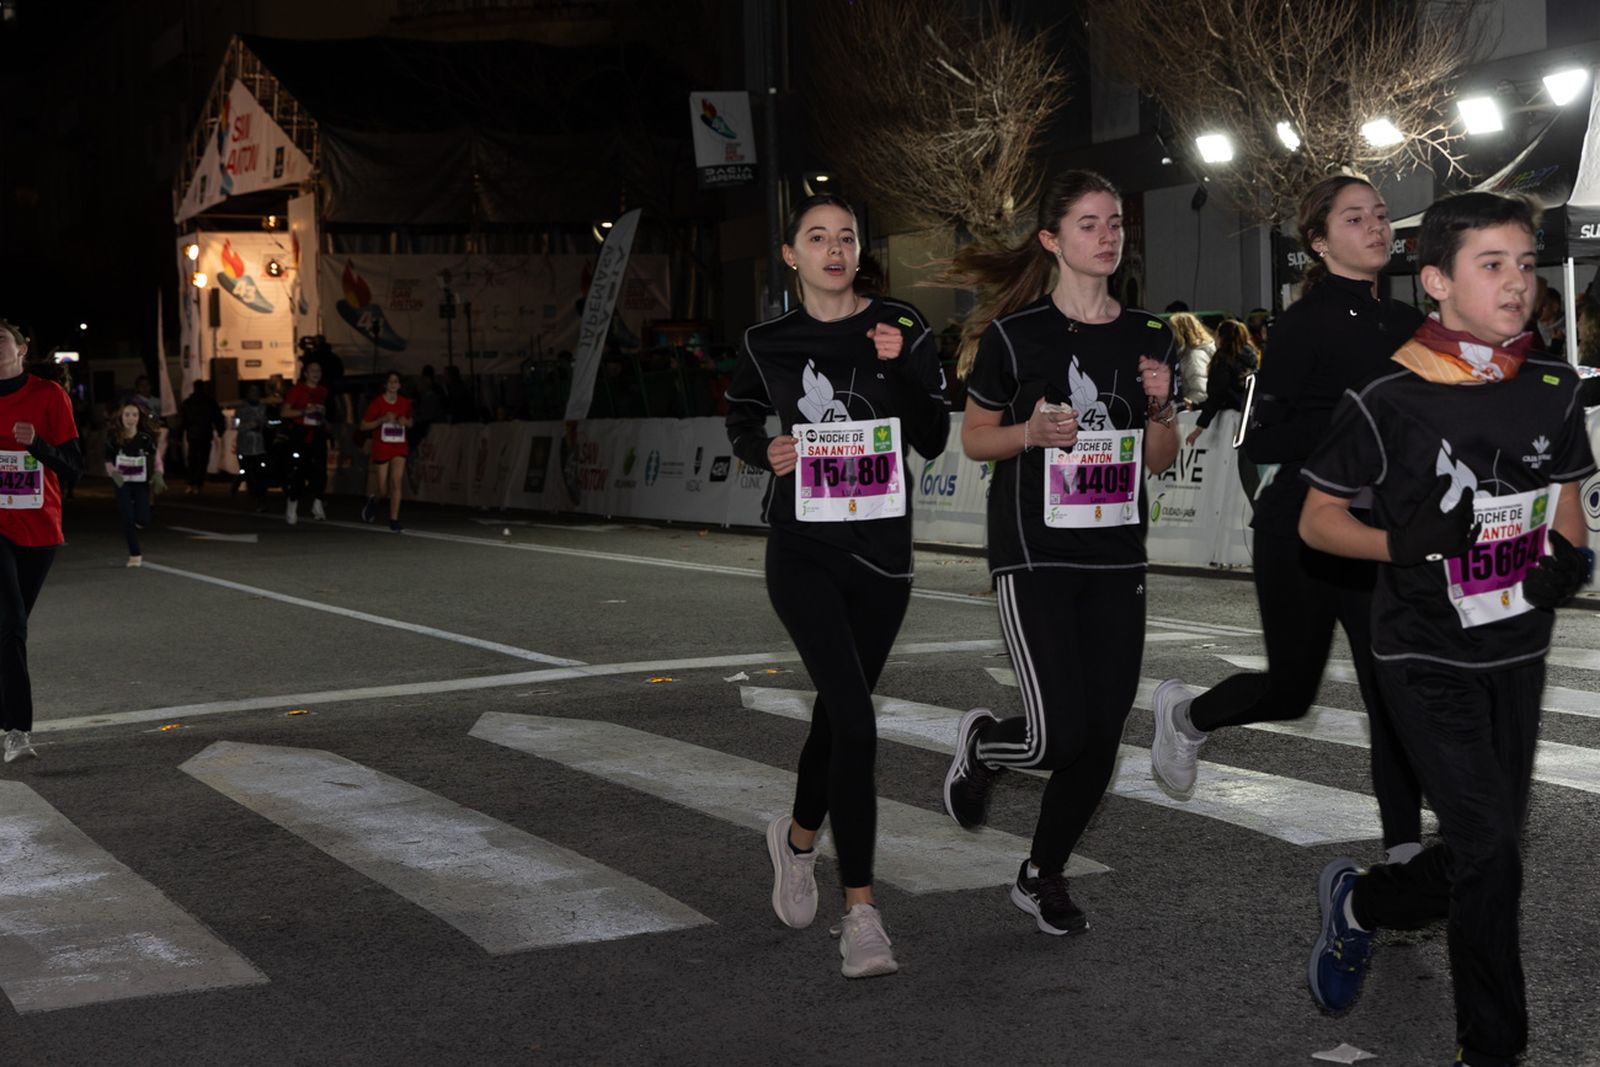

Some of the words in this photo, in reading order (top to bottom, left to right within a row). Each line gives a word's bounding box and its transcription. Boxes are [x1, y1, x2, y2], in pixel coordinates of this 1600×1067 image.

[705, 165, 752, 175] DACIA
[1082, 408, 1106, 431] 43
[819, 433, 850, 443] NOCHE
[852, 433, 865, 442] DE
[808, 446, 829, 456] SAN
[830, 443, 865, 456] ANTÓN
[1076, 442, 1100, 452] OCHE
[1102, 441, 1112, 451] DE
[1080, 451, 1112, 464] ANTÓN
[809, 455, 890, 487] 15480
[1476, 511, 1507, 524] OCHE
[1510, 508, 1523, 520] DE
[1482, 521, 1523, 540] ANTÓN
